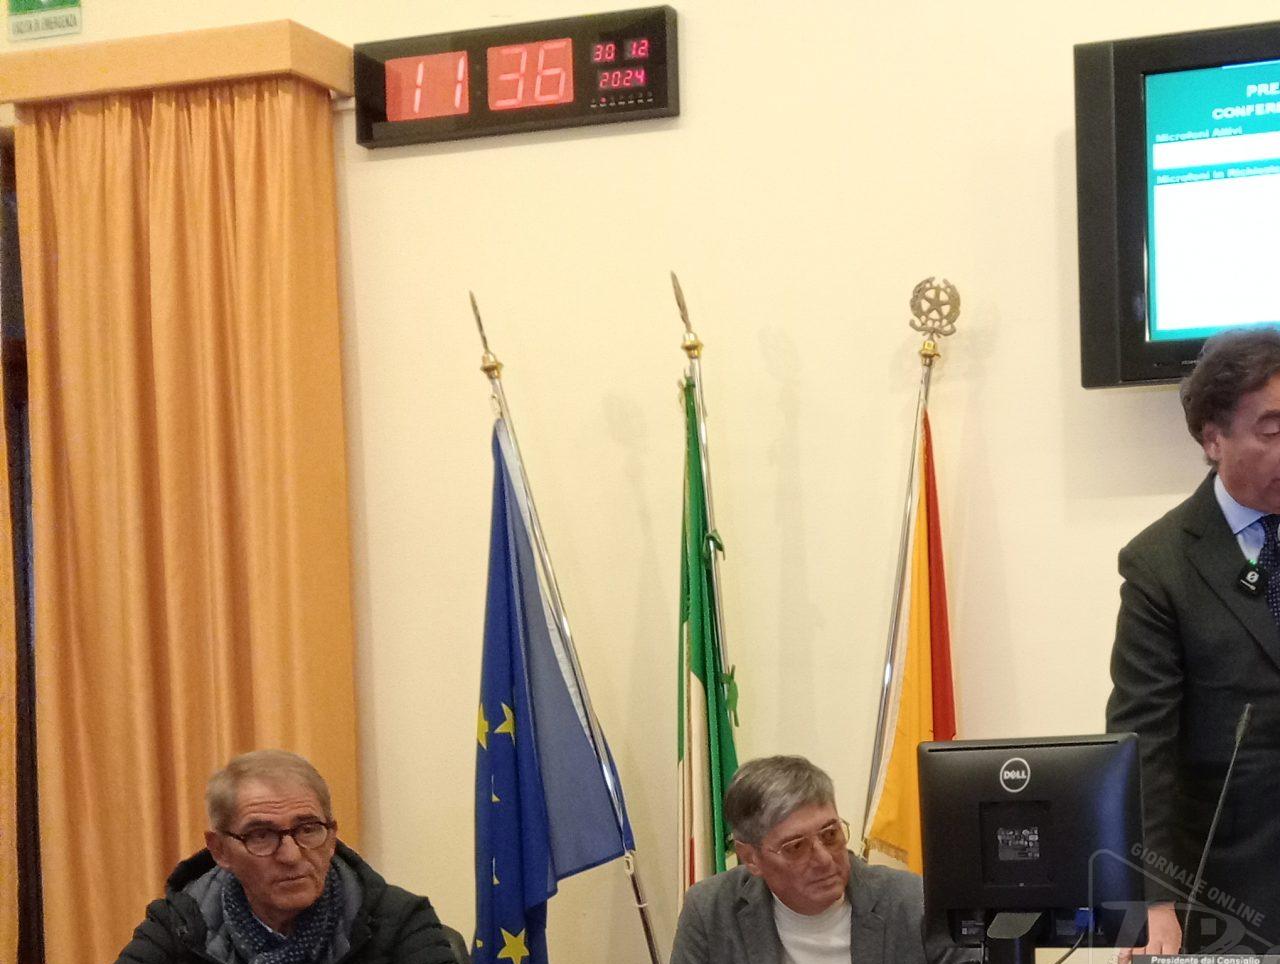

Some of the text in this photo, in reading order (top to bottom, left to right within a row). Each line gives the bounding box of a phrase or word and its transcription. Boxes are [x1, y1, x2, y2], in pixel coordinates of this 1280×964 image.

[593, 40, 649, 61] 30 12
[412, 40, 569, 114] 11 36
[600, 69, 645, 88] 2024
[1003, 770, 1027, 780] DELL
